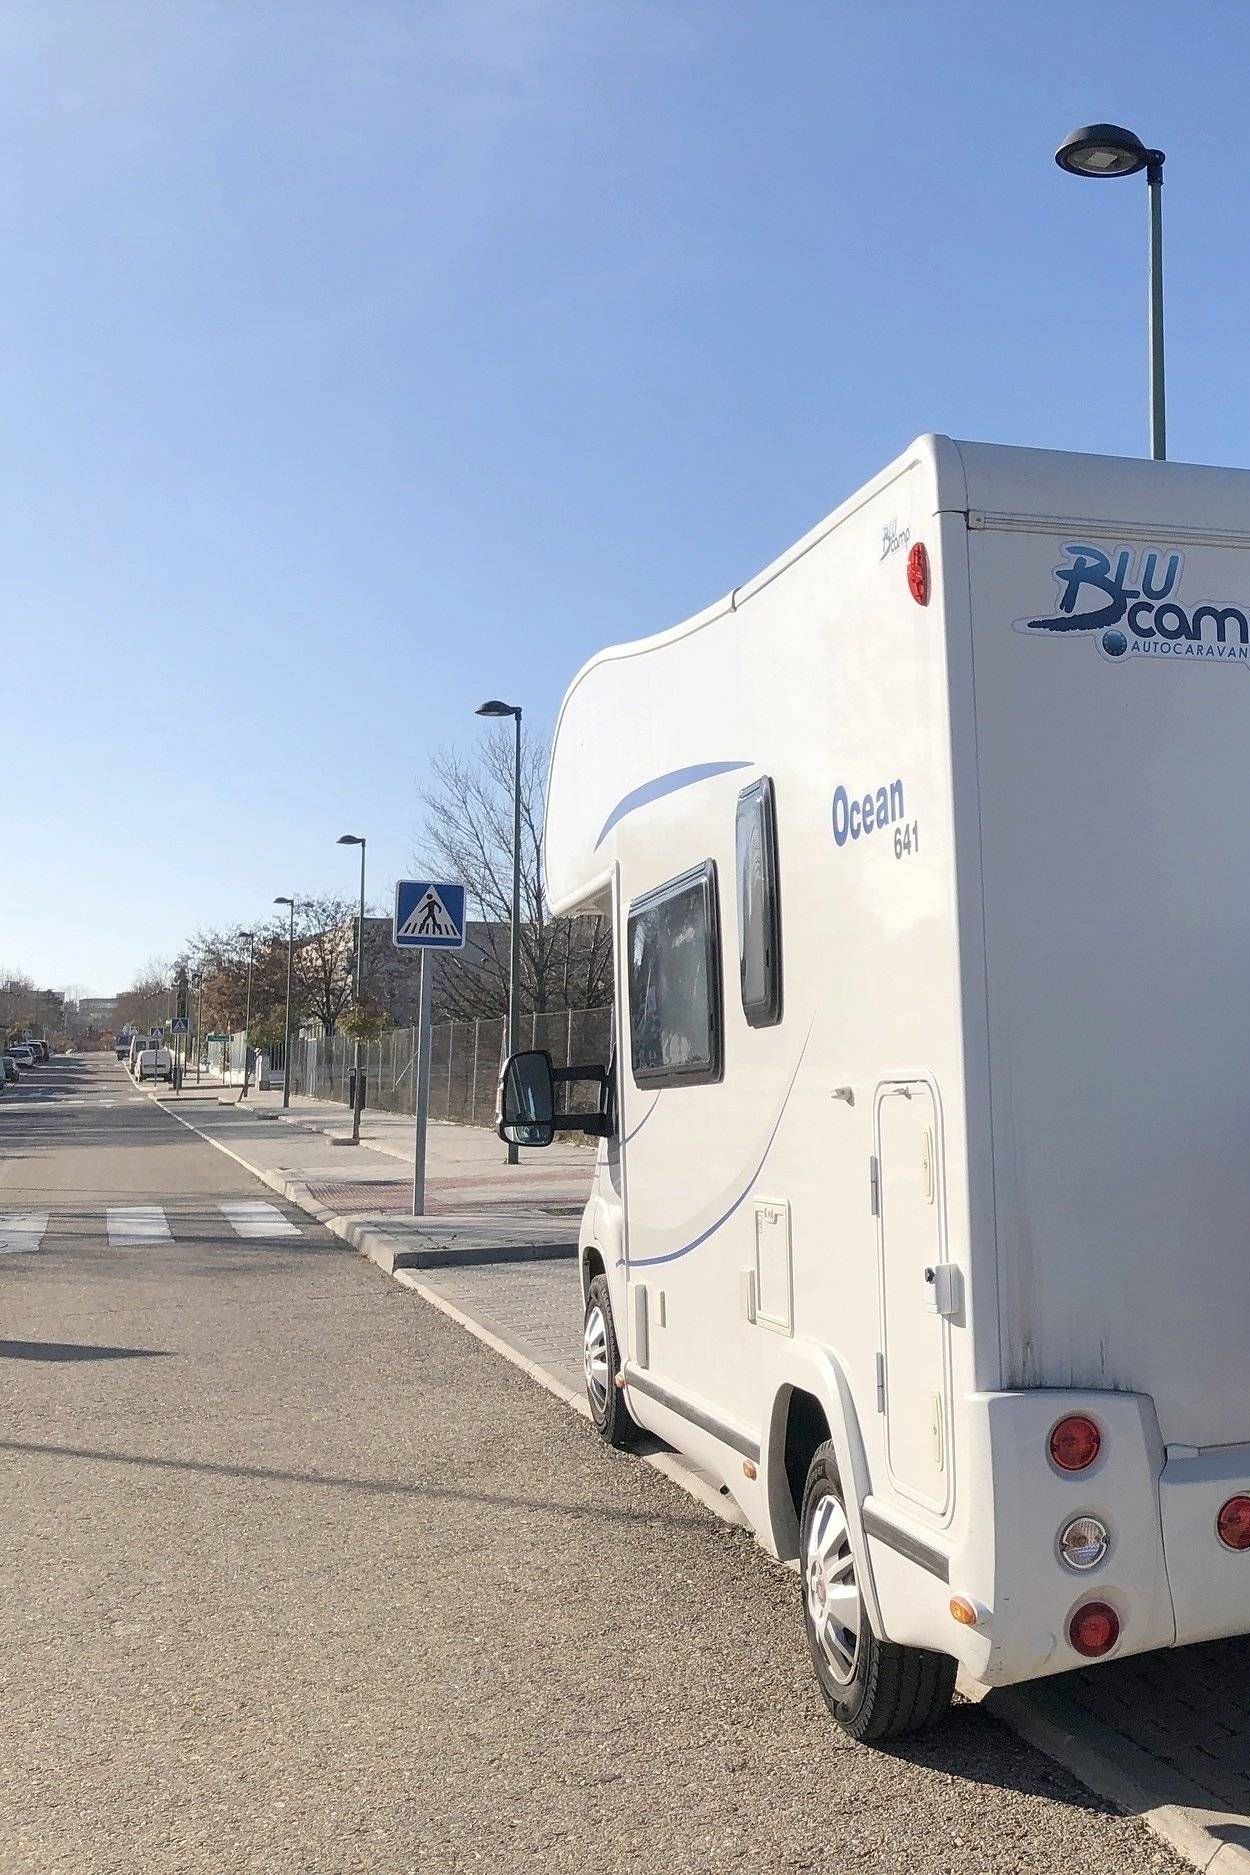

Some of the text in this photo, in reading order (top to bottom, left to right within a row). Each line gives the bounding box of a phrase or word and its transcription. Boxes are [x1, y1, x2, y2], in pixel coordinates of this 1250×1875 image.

[1131, 640, 1249, 659] AUTOCARAVAN
[832, 778, 904, 847] Ocean
[894, 820, 919, 860] 641
